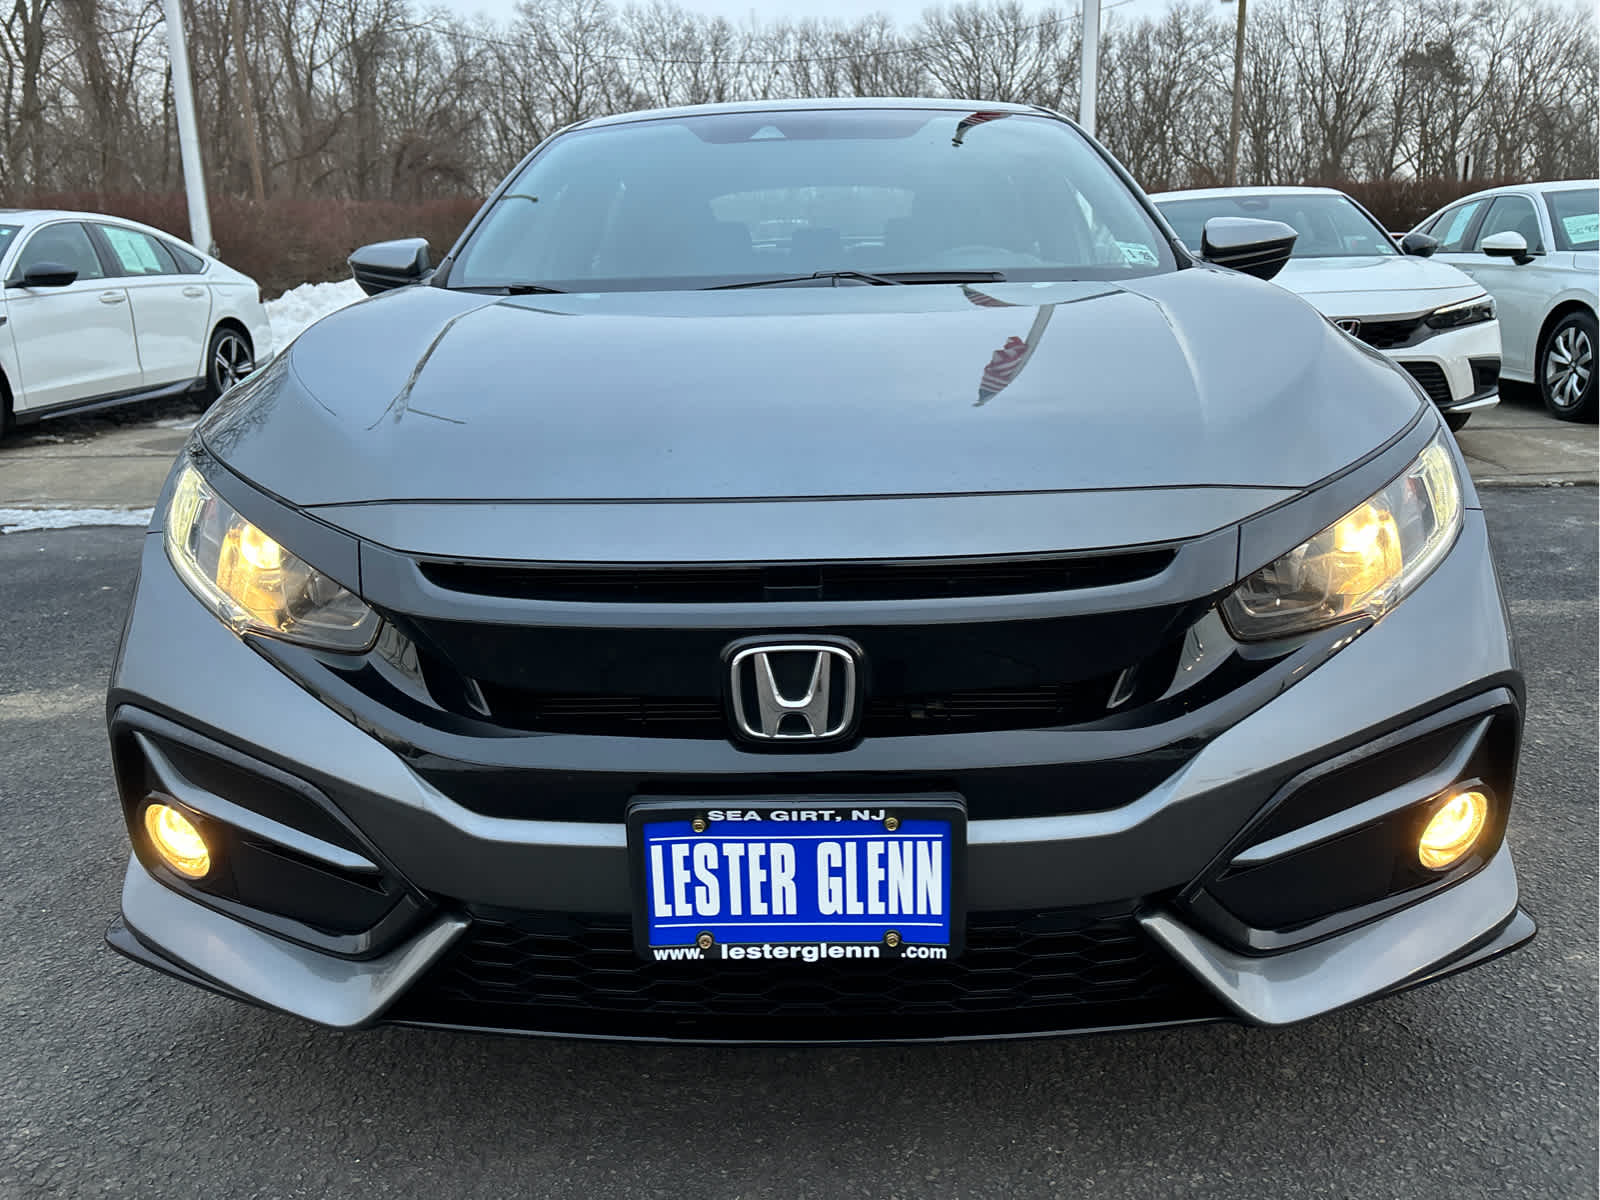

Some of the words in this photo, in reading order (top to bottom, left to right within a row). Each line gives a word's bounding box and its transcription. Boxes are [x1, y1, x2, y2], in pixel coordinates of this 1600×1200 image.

[707, 810, 762, 822] SEA
[769, 810, 842, 823] GIRT,
[851, 809, 886, 821] NJ
[650, 842, 798, 917] LESTER
[816, 840, 943, 916] GLENN
[653, 948, 705, 961] www.
[720, 943, 880, 962] lesterglenn
[900, 946, 947, 960] .com
